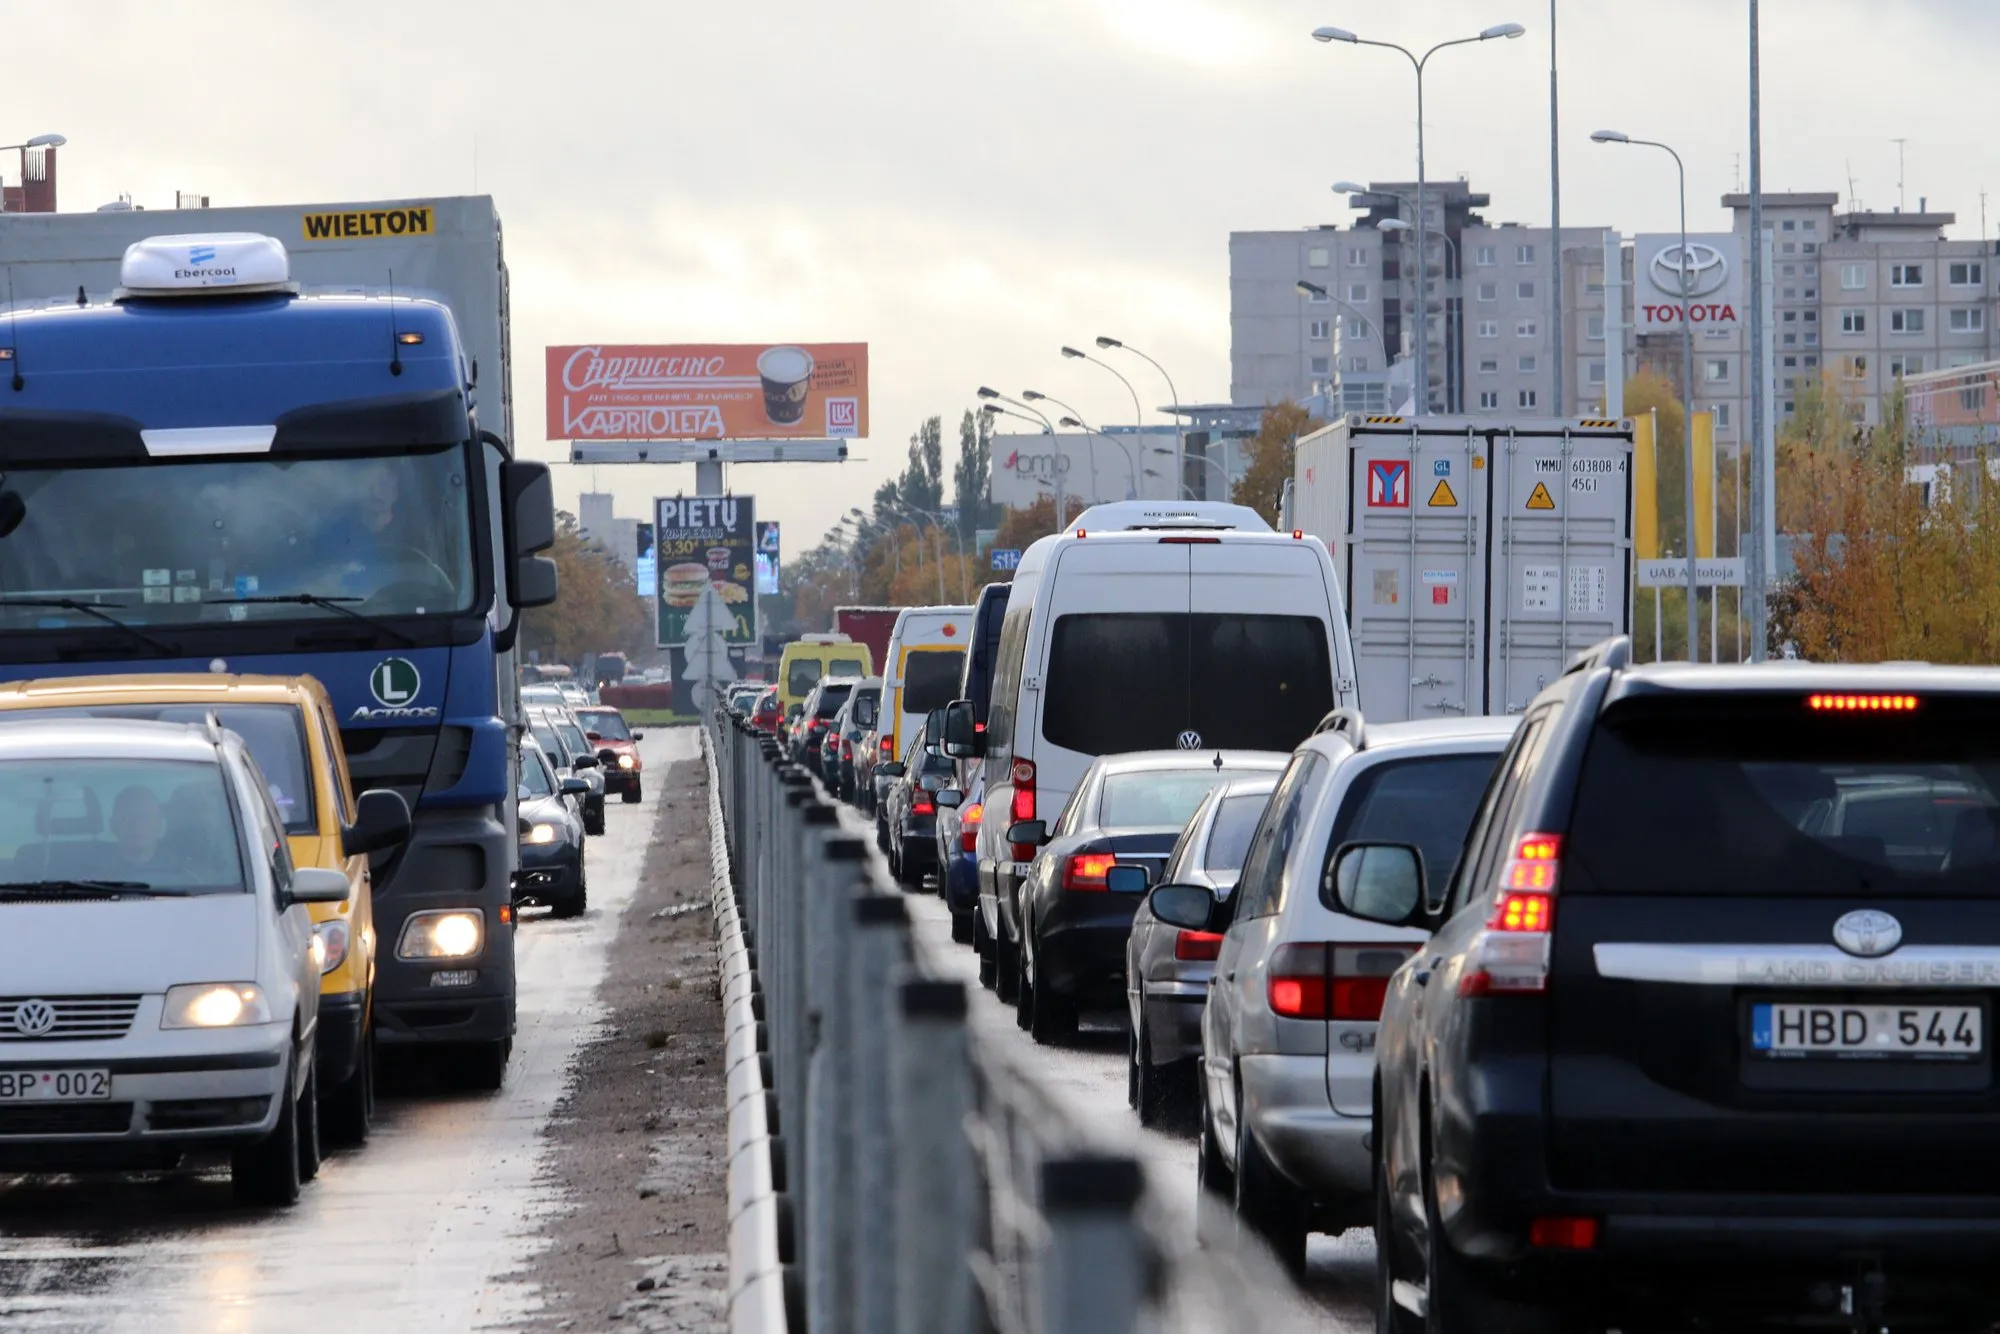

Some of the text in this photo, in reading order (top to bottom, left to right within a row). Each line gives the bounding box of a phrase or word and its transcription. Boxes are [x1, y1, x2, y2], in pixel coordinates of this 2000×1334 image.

[305, 208, 428, 238] WIELTON
[175, 267, 237, 279] Ebercool
[1642, 304, 1737, 323] TOYOTA
[1435, 462, 1449, 472] GL
[1535, 459, 1625, 472] YMMU 603808 4
[1572, 478, 1597, 492] 45G1
[660, 500, 737, 532] PIETŲ
[1649, 565, 1734, 580] UAB Atotoja
[383, 665, 408, 700] L
[1737, 958, 2000, 984] LAND CRUISER
[1778, 1009, 1974, 1047] HBD 544
[0, 1072, 105, 1097] BP 002
